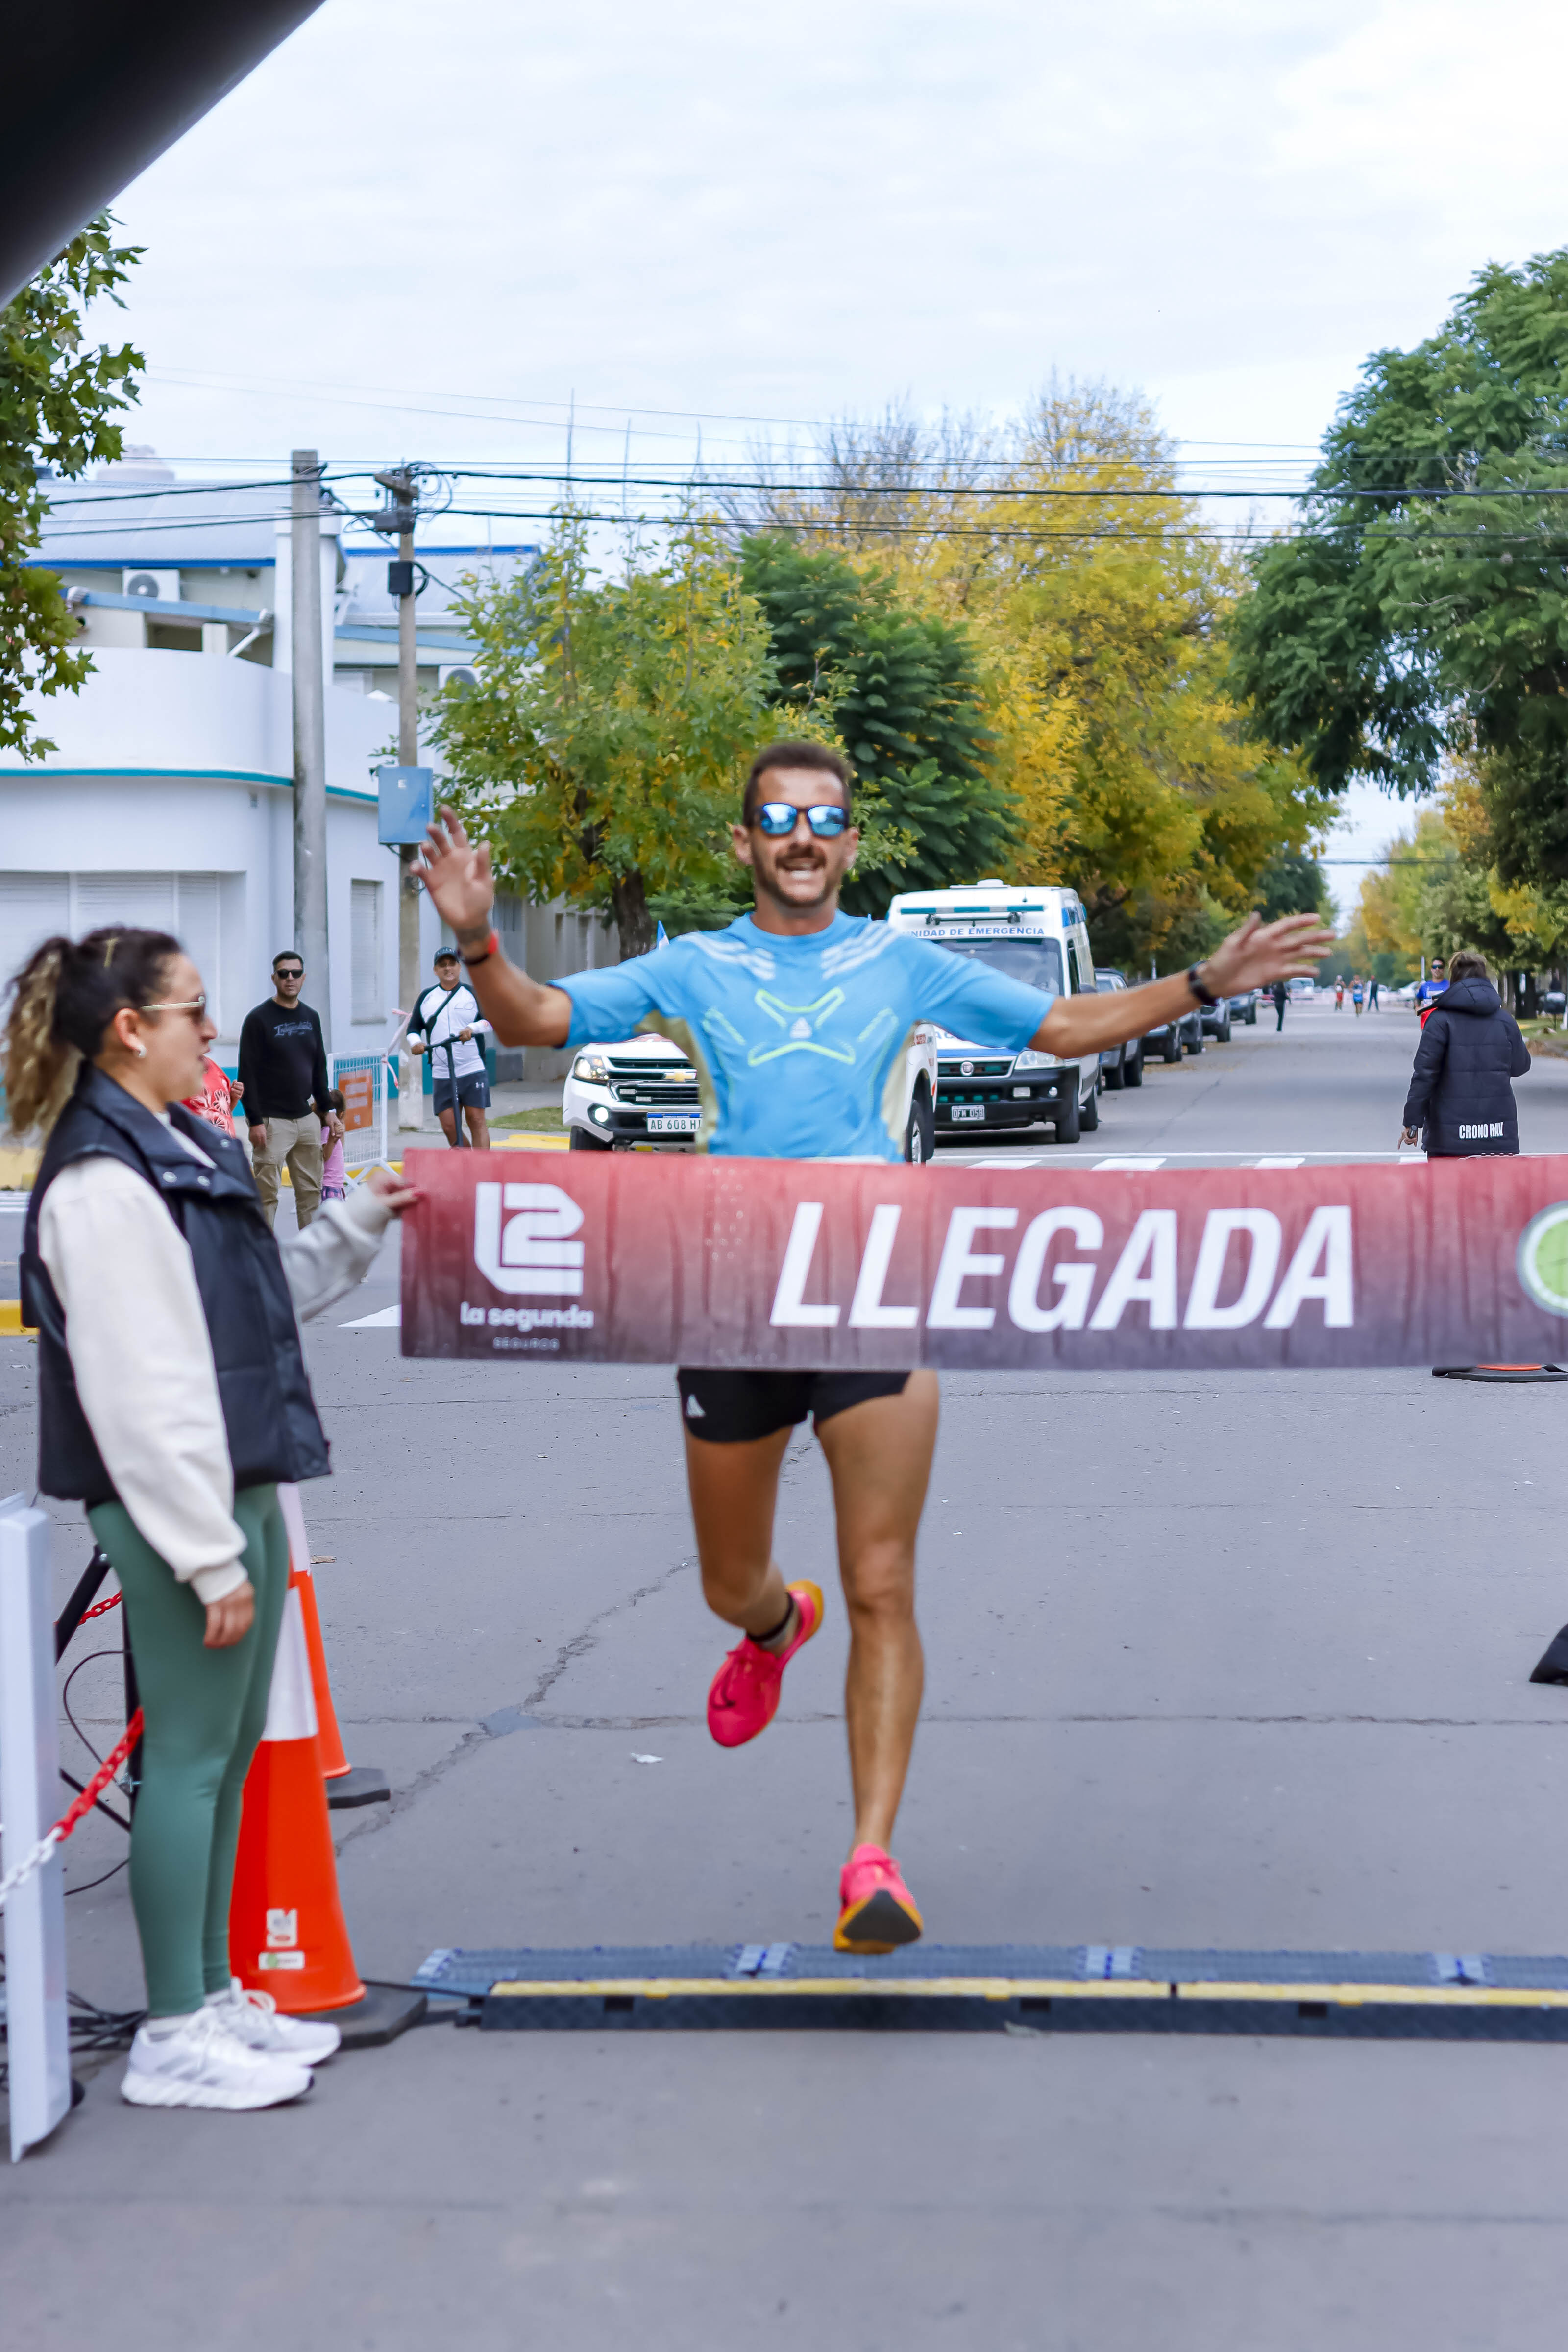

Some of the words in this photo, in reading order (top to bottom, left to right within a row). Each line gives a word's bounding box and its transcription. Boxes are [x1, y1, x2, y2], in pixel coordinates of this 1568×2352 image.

[651, 1120, 663, 1129] AB
[667, 1119, 686, 1129] 608
[1459, 1123, 1489, 1139] CRONO
[769, 1202, 1353, 1332] LLEGADA
[460, 1301, 486, 1326] la
[487, 1304, 594, 1332] segunda
